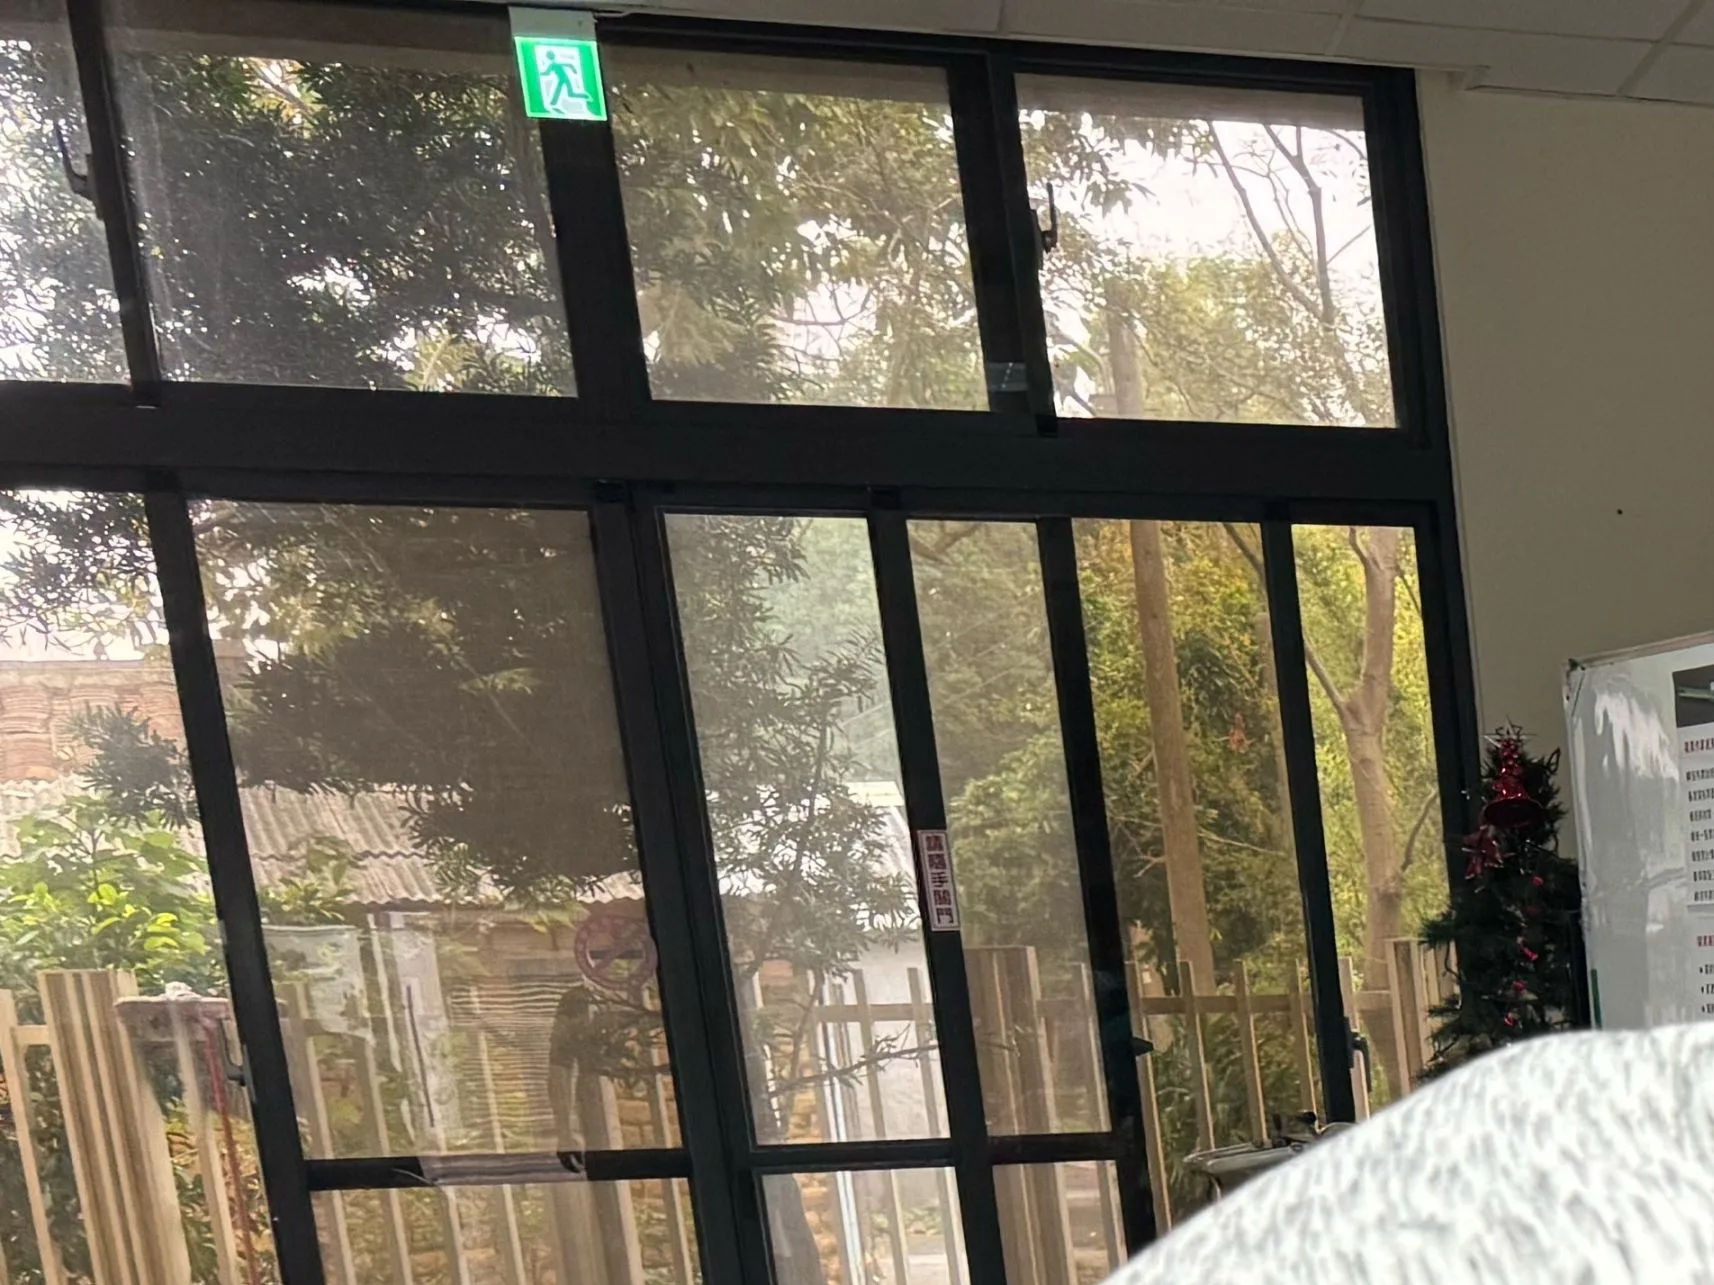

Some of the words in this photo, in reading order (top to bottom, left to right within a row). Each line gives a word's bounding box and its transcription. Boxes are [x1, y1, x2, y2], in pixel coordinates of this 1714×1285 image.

[925, 835, 955, 925] 請隨手關門
